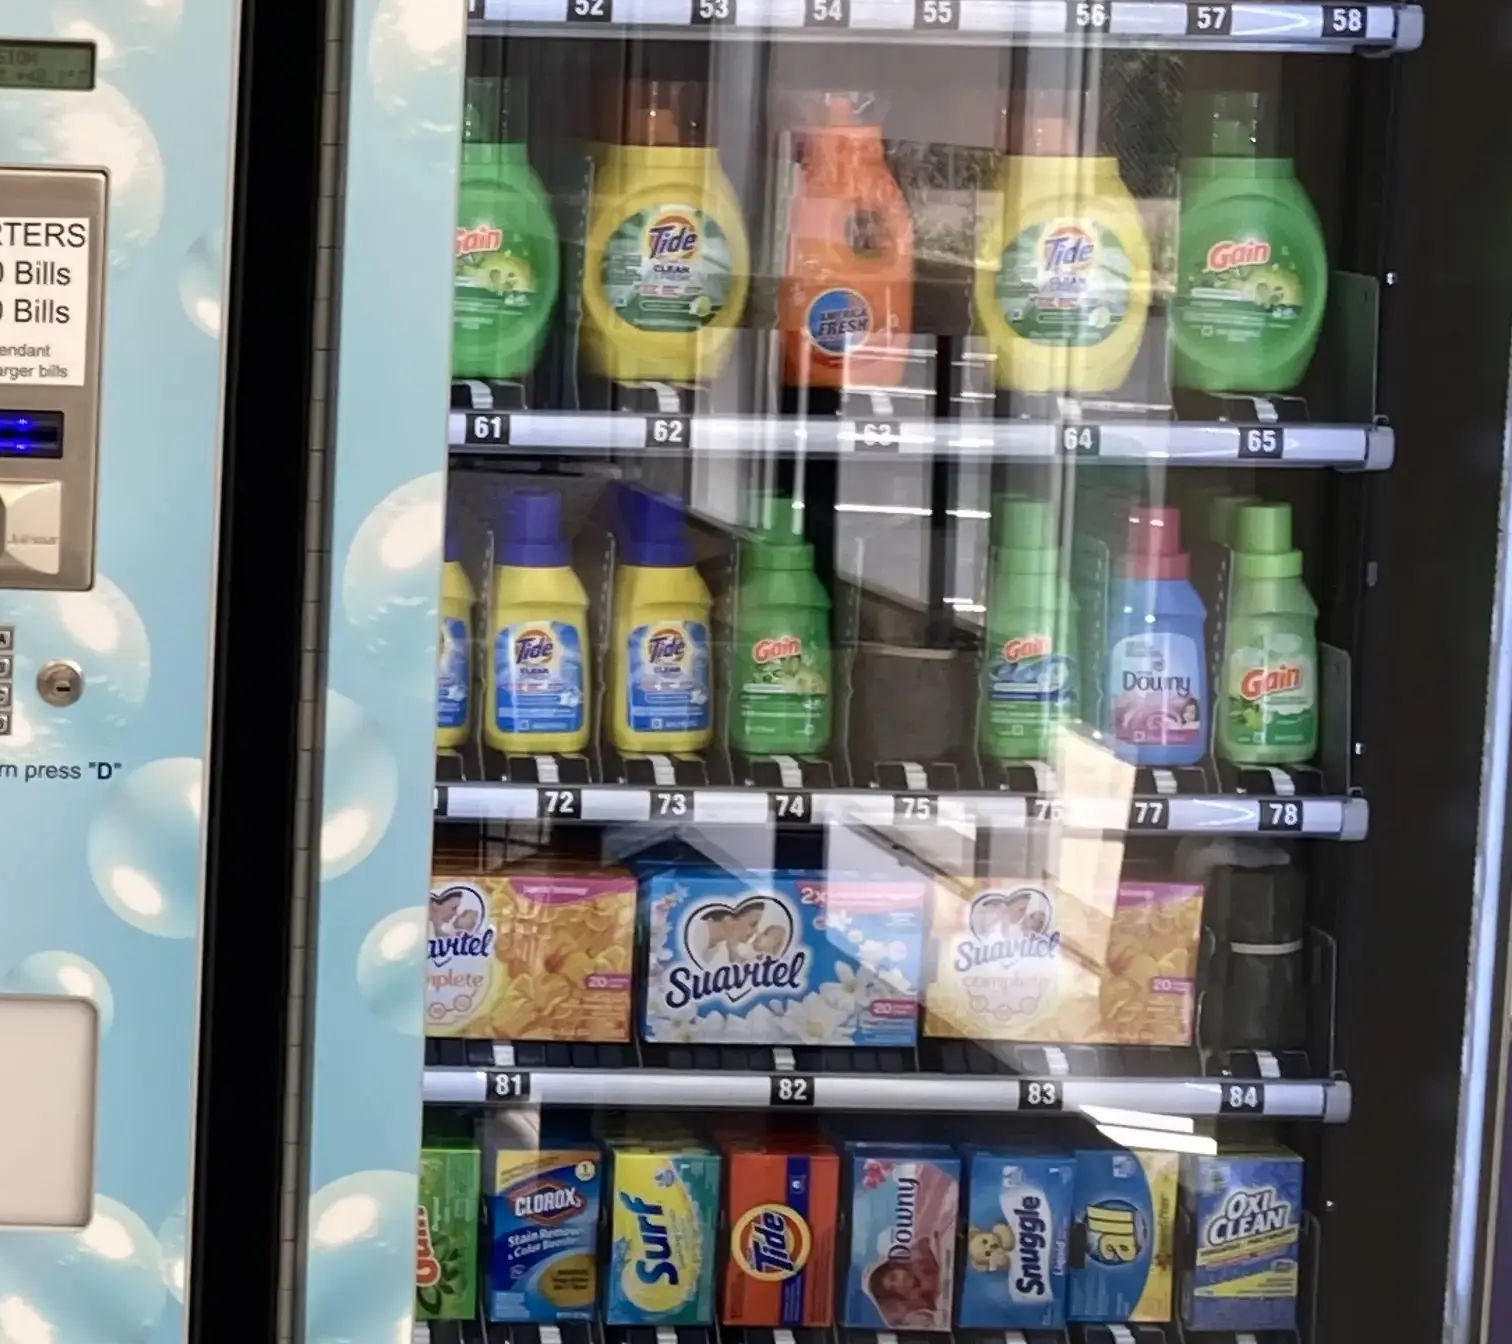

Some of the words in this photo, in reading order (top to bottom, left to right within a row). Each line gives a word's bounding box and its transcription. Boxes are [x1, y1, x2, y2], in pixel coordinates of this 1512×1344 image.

[813, 0, 843, 22] 54
[923, 0, 953, 23] 55
[1076, 3, 1105, 26] 56
[1198, 6, 1226, 29] 57
[1333, 9, 1363, 32] 58
[648, 225, 698, 259] Tide
[1044, 236, 1094, 271] Tide
[1208, 241, 1269, 269] Gain
[15, 260, 71, 286] Bills
[14, 298, 70, 324] Bills
[819, 318, 869, 336] FRESH
[38, 364, 68, 379] bills
[474, 417, 502, 438] 61
[654, 420, 683, 442] 62
[1064, 429, 1093, 450] 64
[1247, 430, 1276, 452] 65
[516, 636, 553, 664] Tide
[649, 635, 685, 663] Tide
[754, 636, 801, 662] Gain
[1241, 664, 1302, 701] Gain
[25, 763, 81, 783] press
[89, 762, 121, 780] "D"
[545, 792, 574, 813] 72
[658, 794, 686, 816] 73
[776, 796, 804, 817] 74
[902, 798, 930, 819] 75
[1135, 802, 1163, 823] 77
[1269, 803, 1298, 825] 78
[954, 930, 1060, 972] Suavitel
[666, 951, 806, 1008] Suavitel
[1153, 979, 1171, 991] 20
[495, 1074, 522, 1095] 81
[778, 1079, 807, 1101] 82
[1027, 1083, 1056, 1104] 83
[1229, 1086, 1257, 1108] 84
[1225, 1190, 1274, 1217] OXI
[888, 1175, 919, 1261] Downy
[1209, 1205, 1289, 1246] CLEAN
[749, 1208, 794, 1274] Tide
[1087, 1203, 1136, 1262] all
[1016, 1195, 1045, 1296] Snuggle
